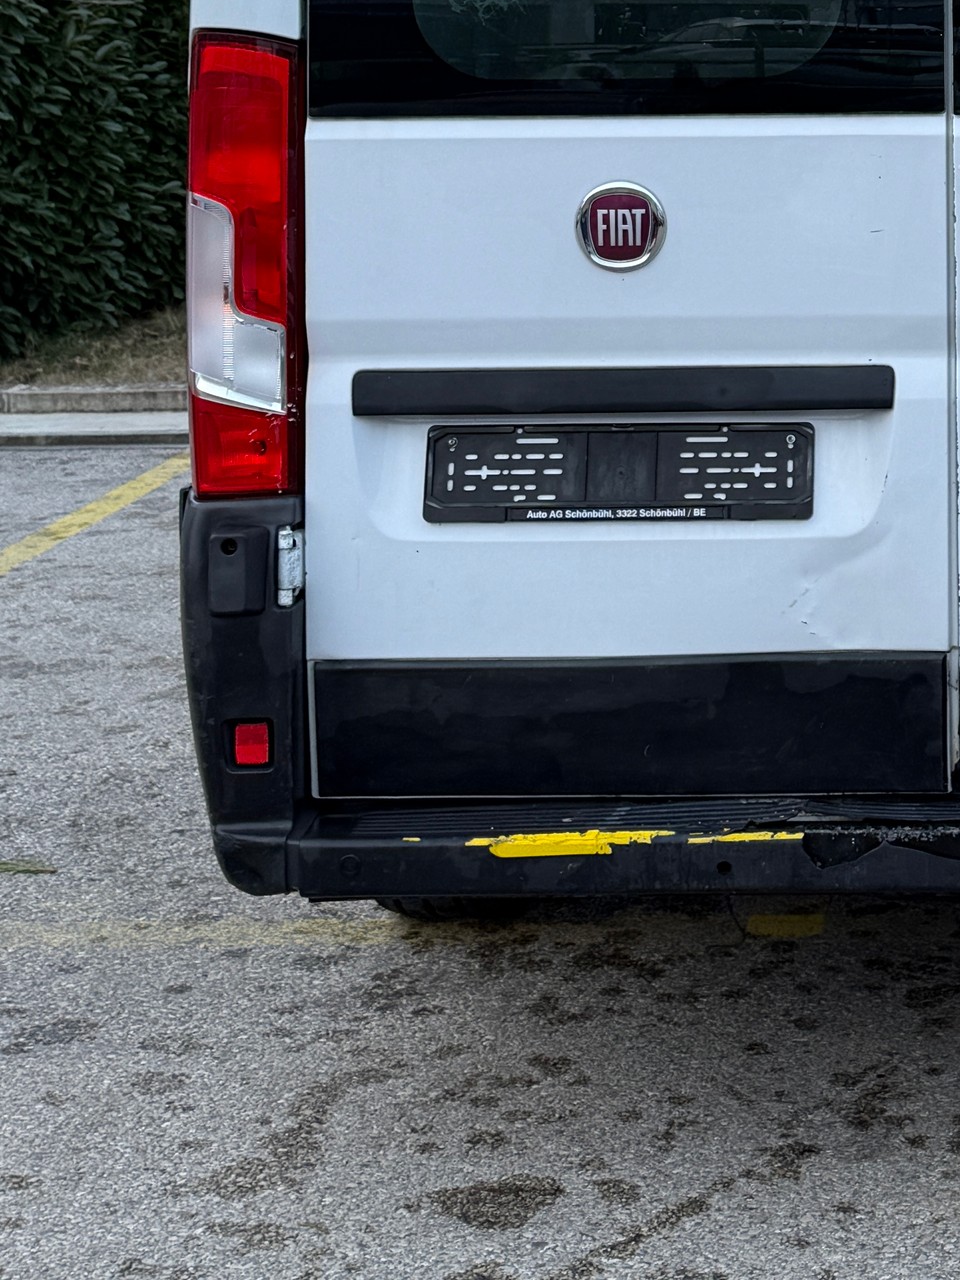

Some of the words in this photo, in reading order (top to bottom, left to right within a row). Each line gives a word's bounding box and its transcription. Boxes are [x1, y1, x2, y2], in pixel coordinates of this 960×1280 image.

[596, 208, 646, 247] FIAT
[526, 509, 548, 519] Auto
[549, 509, 563, 519] AG
[565, 508, 615, 519] Schönbühl,
[616, 509, 638, 518] 3322
[639, 508, 686, 517] Schönbühl
[693, 508, 707, 517] BE
